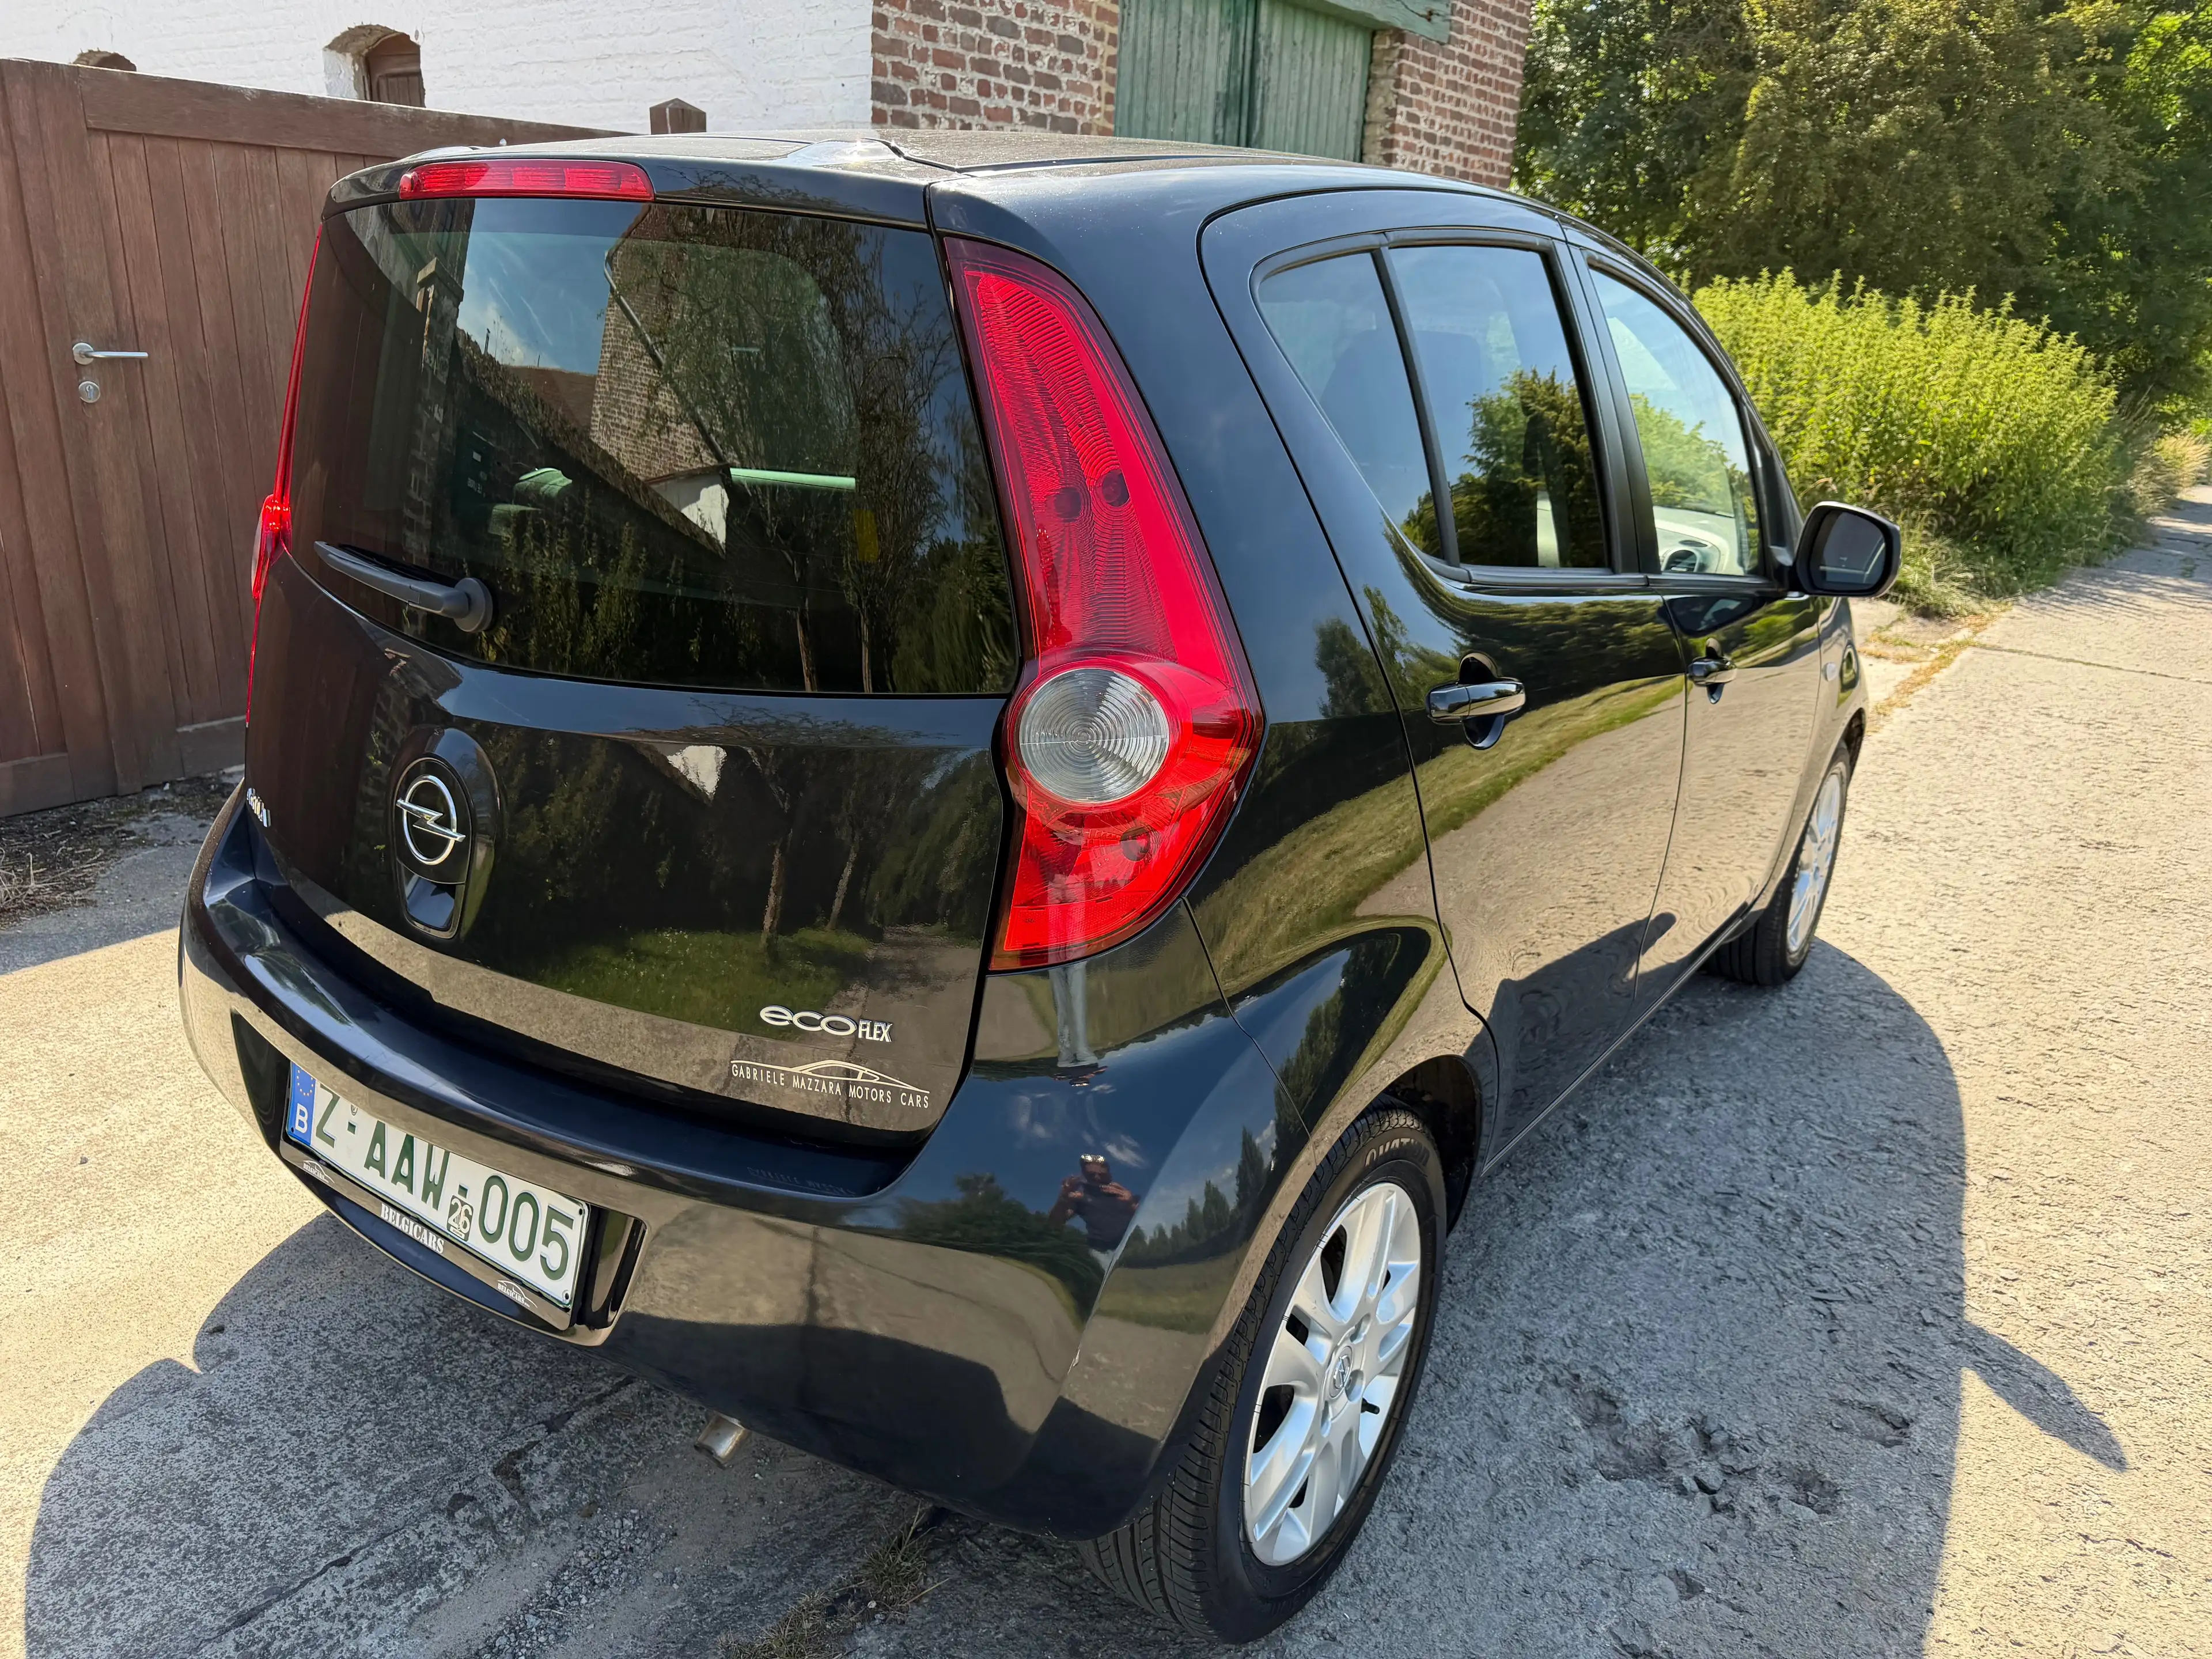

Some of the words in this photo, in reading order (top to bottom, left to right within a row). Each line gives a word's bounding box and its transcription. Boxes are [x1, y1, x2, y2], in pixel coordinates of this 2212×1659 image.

[732, 1064, 785, 1086] GABRIELE
[793, 1075, 842, 1095] MAZZARA
[849, 1084, 892, 1104] MOTORS
[900, 1092, 929, 1109] CARS
[295, 1102, 309, 1133] B
[381, 1203, 445, 1254] BELGICARS
[498, 1282, 525, 1304] BELGICARS
